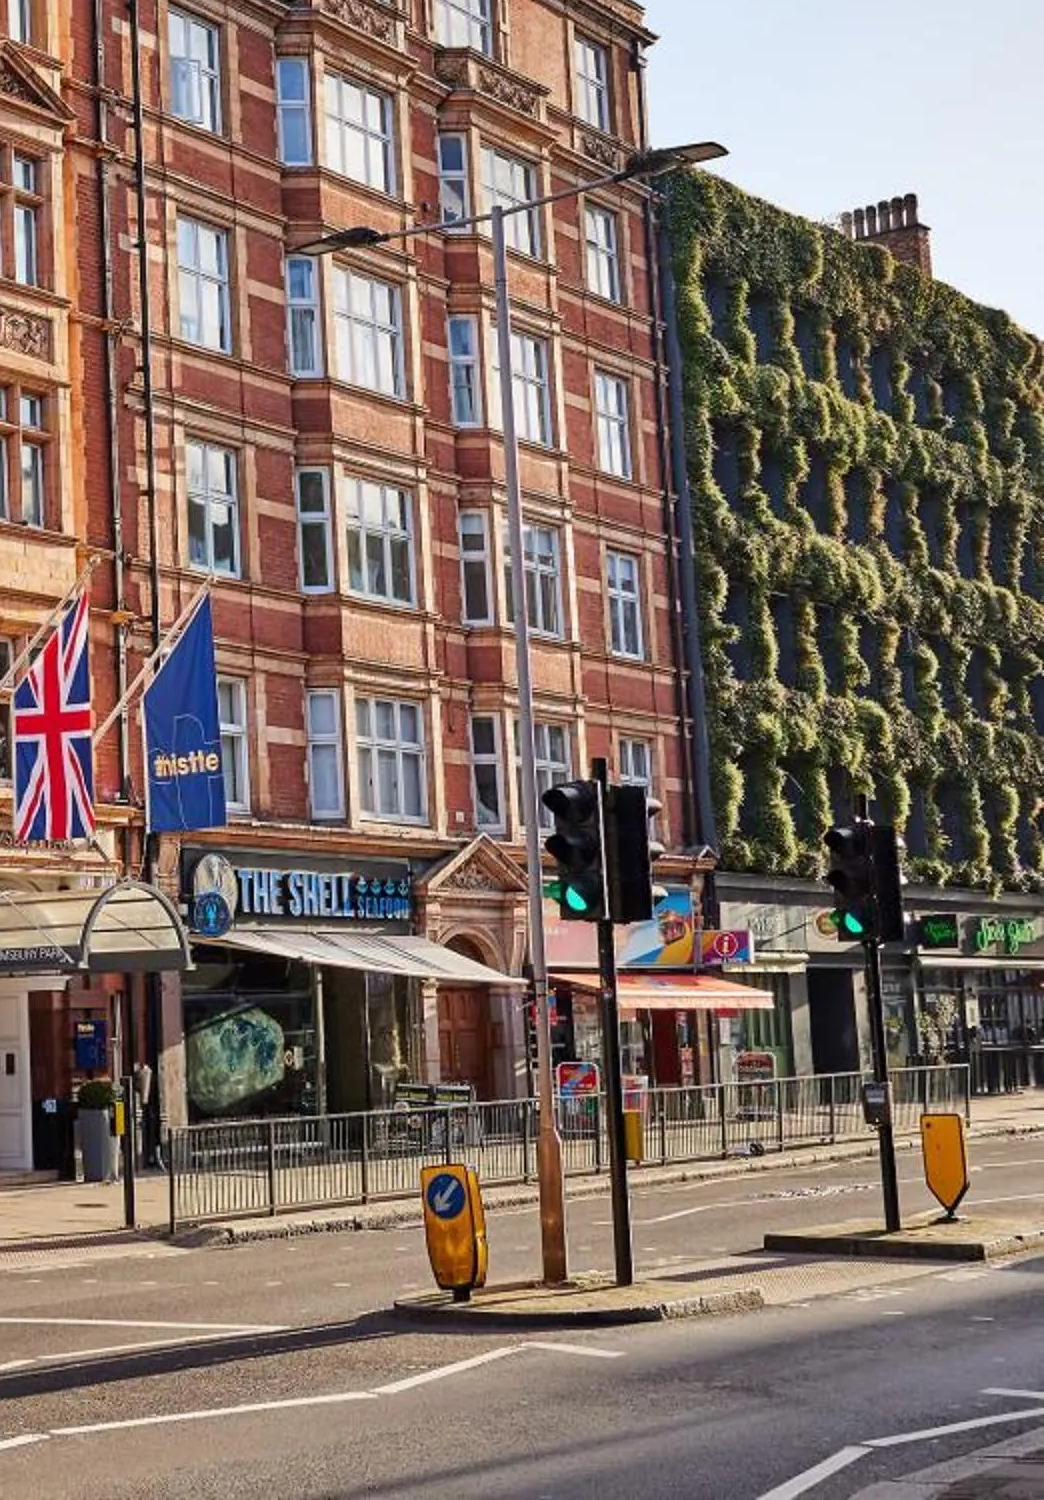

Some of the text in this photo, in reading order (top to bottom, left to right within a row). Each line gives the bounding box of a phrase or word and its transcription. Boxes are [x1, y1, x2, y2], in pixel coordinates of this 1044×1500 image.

[154, 750, 219, 777] thistle
[239, 867, 284, 914] THE
[288, 870, 355, 917] SHELL
[357, 896, 409, 919] SEAFOOD
